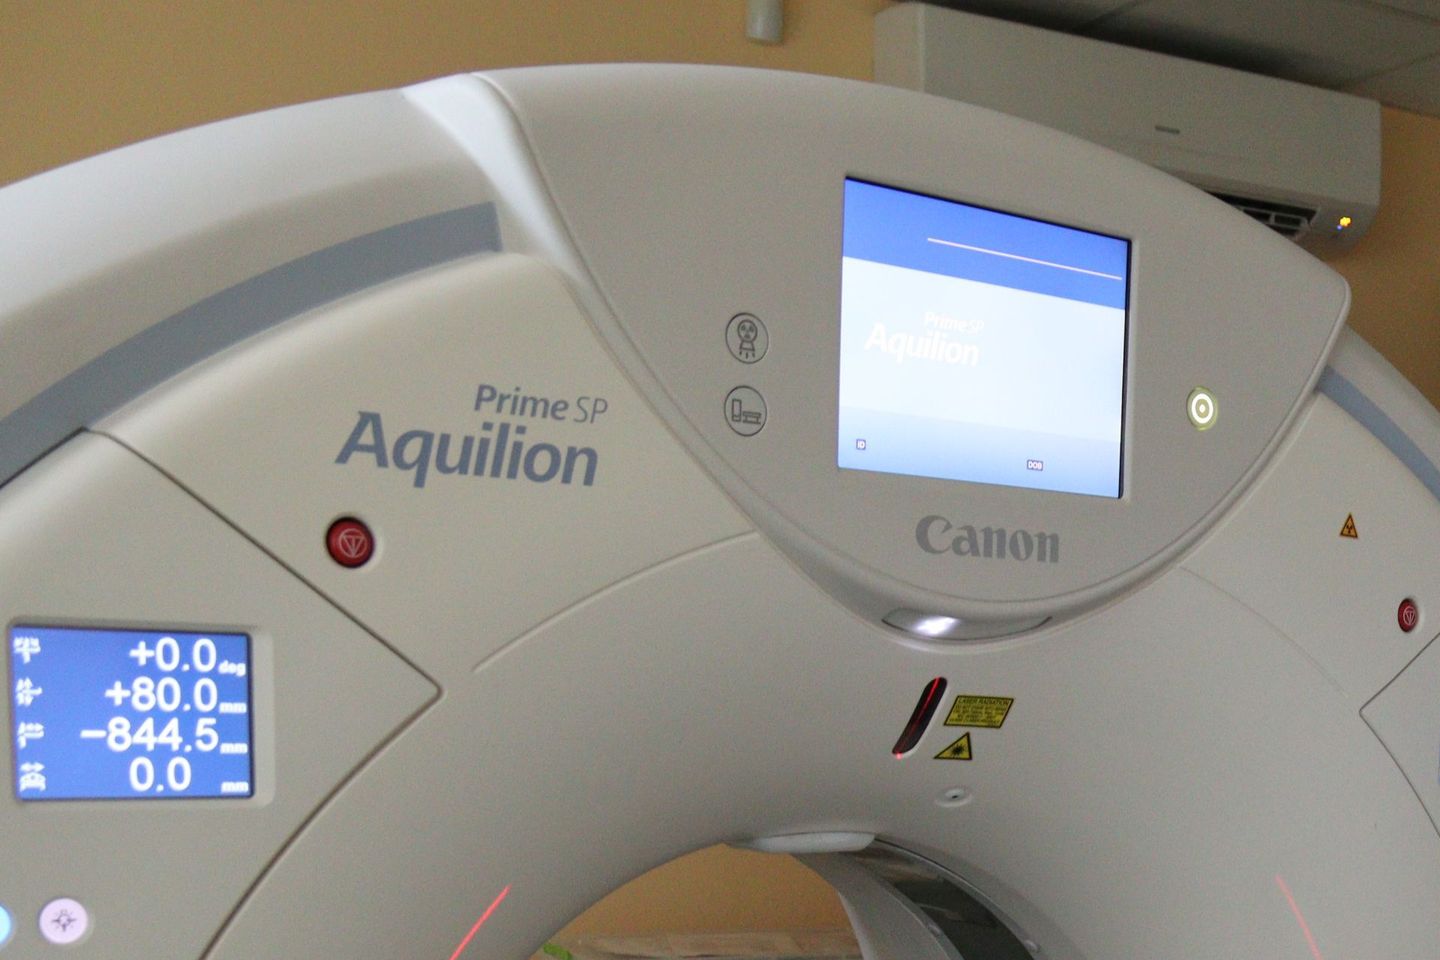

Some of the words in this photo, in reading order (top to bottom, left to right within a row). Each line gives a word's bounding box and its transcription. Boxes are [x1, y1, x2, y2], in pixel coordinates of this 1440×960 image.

[924, 311, 968, 332] Prime
[864, 320, 979, 367] Aquilion
[473, 383, 569, 421] Prime
[574, 396, 608, 424] SP
[334, 410, 598, 488] Aquilion
[915, 514, 1060, 563] Canon
[129, 637, 217, 672] +0.0
[218, 660, 247, 677] deg
[105, 676, 218, 712] +80.0
[219, 702, 247, 714] mm
[80, 716, 219, 752] -844.5
[220, 743, 248, 754] mm
[129, 756, 192, 792] 0.0
[221, 781, 249, 793] mm
